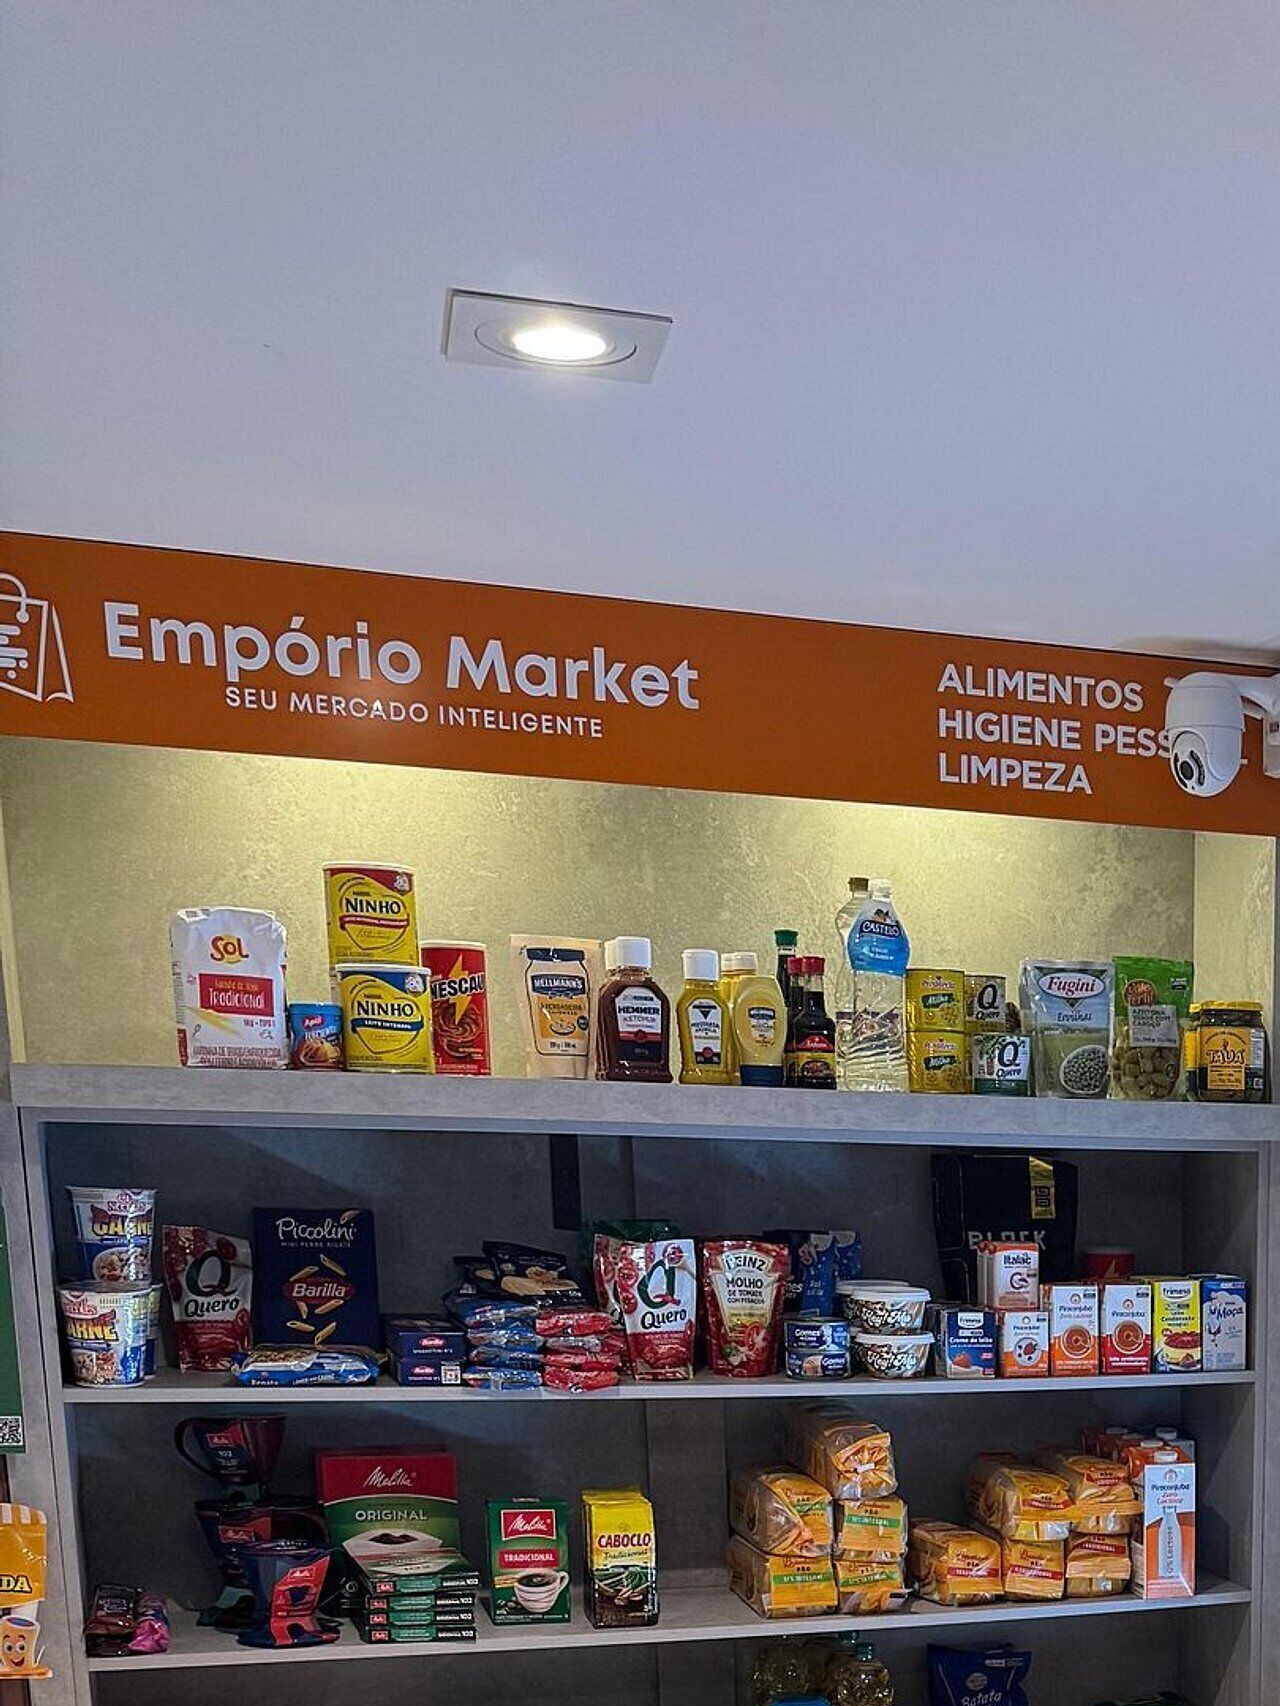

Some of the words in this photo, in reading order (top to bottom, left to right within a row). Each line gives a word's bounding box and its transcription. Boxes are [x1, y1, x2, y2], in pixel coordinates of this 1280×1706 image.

[104, 601, 422, 685] Empório
[446, 636, 700, 711] Market
[937, 663, 1144, 713] ALIMENTOS
[225, 686, 277, 710] SEU
[289, 692, 429, 723] MERCADO
[438, 705, 603, 738] INTELIGENTE
[938, 708, 1083, 752] HIGIENE
[938, 752, 1093, 795] LIMPEZA
[345, 897, 401, 914] NINHO
[1047, 976, 1098, 1000] Fugini
[357, 1000, 414, 1017] NINHO
[275, 1217, 355, 1241] Piccolini
[1003, 1253, 1032, 1266] Italac
[292, 1283, 347, 1298] Barilla
[726, 1277, 764, 1289] MOLHO
[184, 1297, 241, 1318] Quero
[640, 1309, 687, 1330] Quero
[362, 1466, 414, 1488] Melitta
[355, 1508, 428, 1522] ORIGINAL
[508, 1514, 548, 1532] Melitta
[597, 1532, 652, 1549] CABOCLO
[503, 1553, 555, 1563] TRADICIONAL
[0, 1572, 33, 1594] DA
